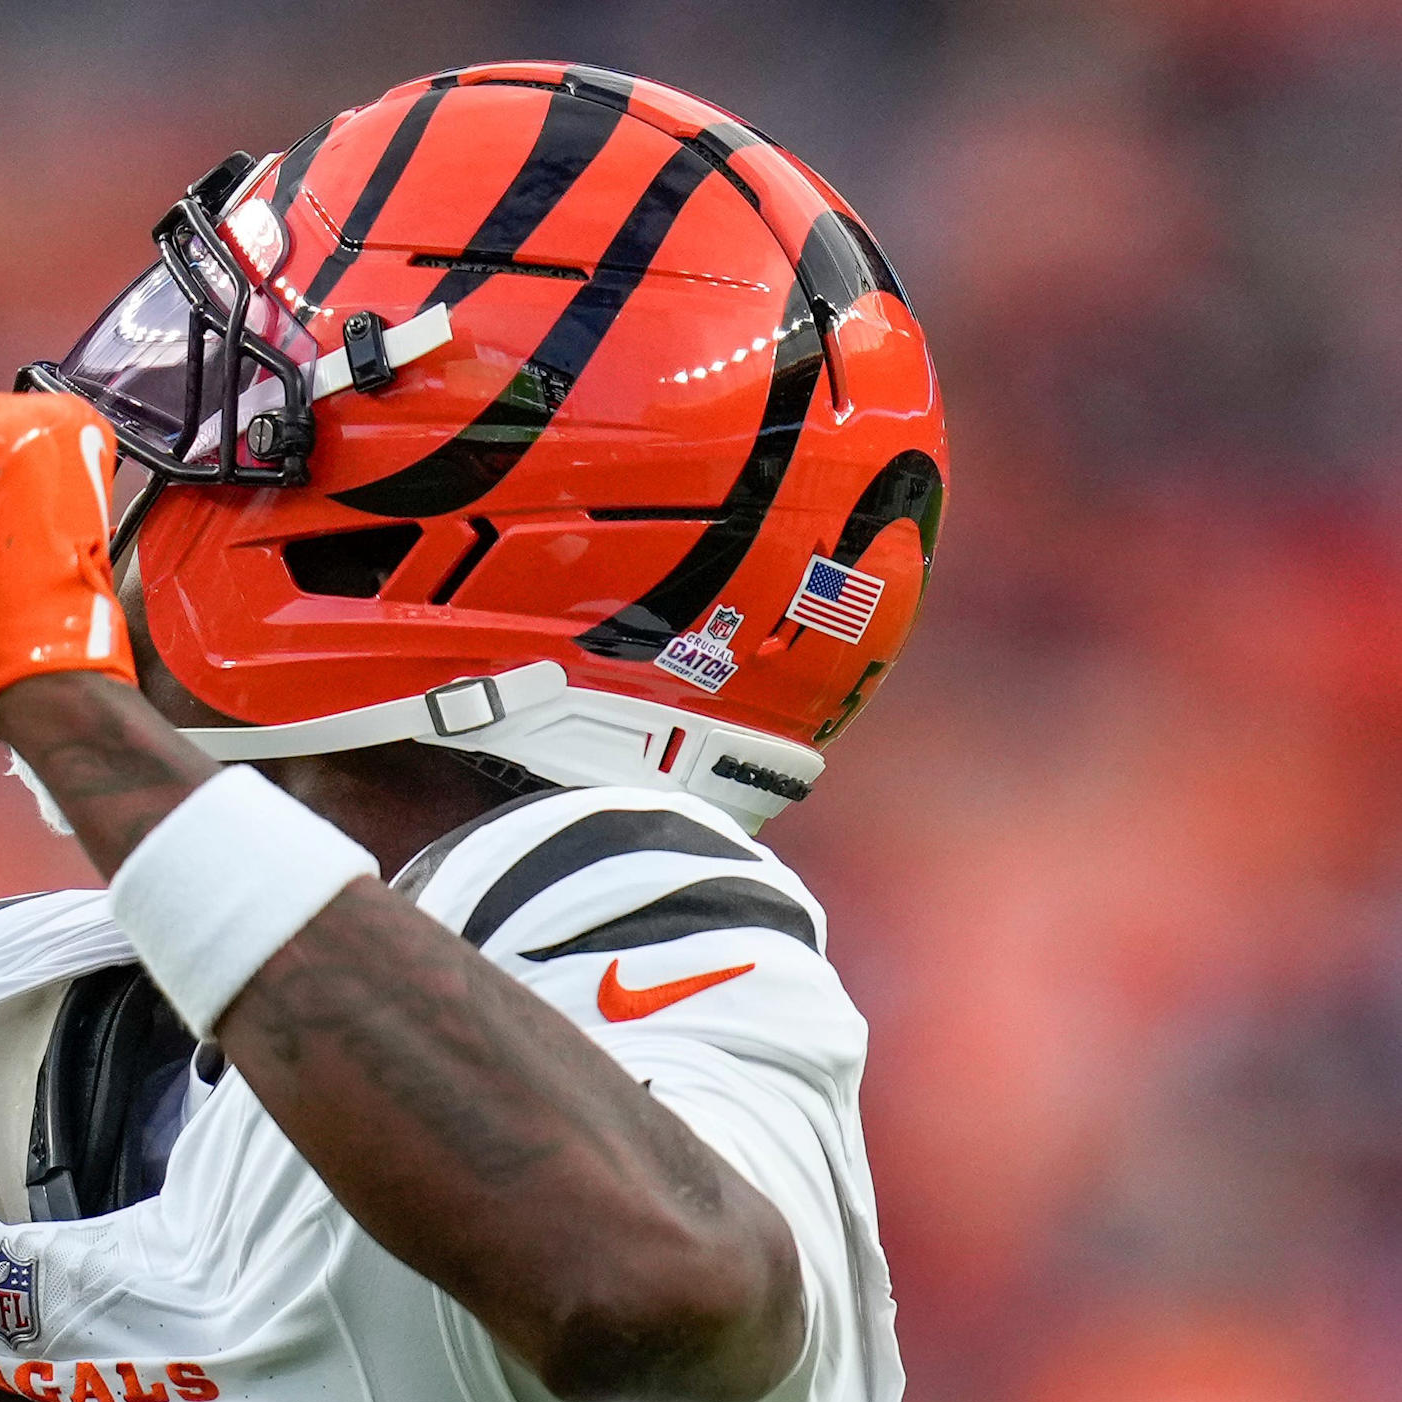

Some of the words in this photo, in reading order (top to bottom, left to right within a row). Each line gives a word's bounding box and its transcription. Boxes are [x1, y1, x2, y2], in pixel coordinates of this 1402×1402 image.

[710, 620, 731, 638] NFL
[667, 641, 735, 683] CATCH
[686, 634, 731, 663] CRUCIAL
